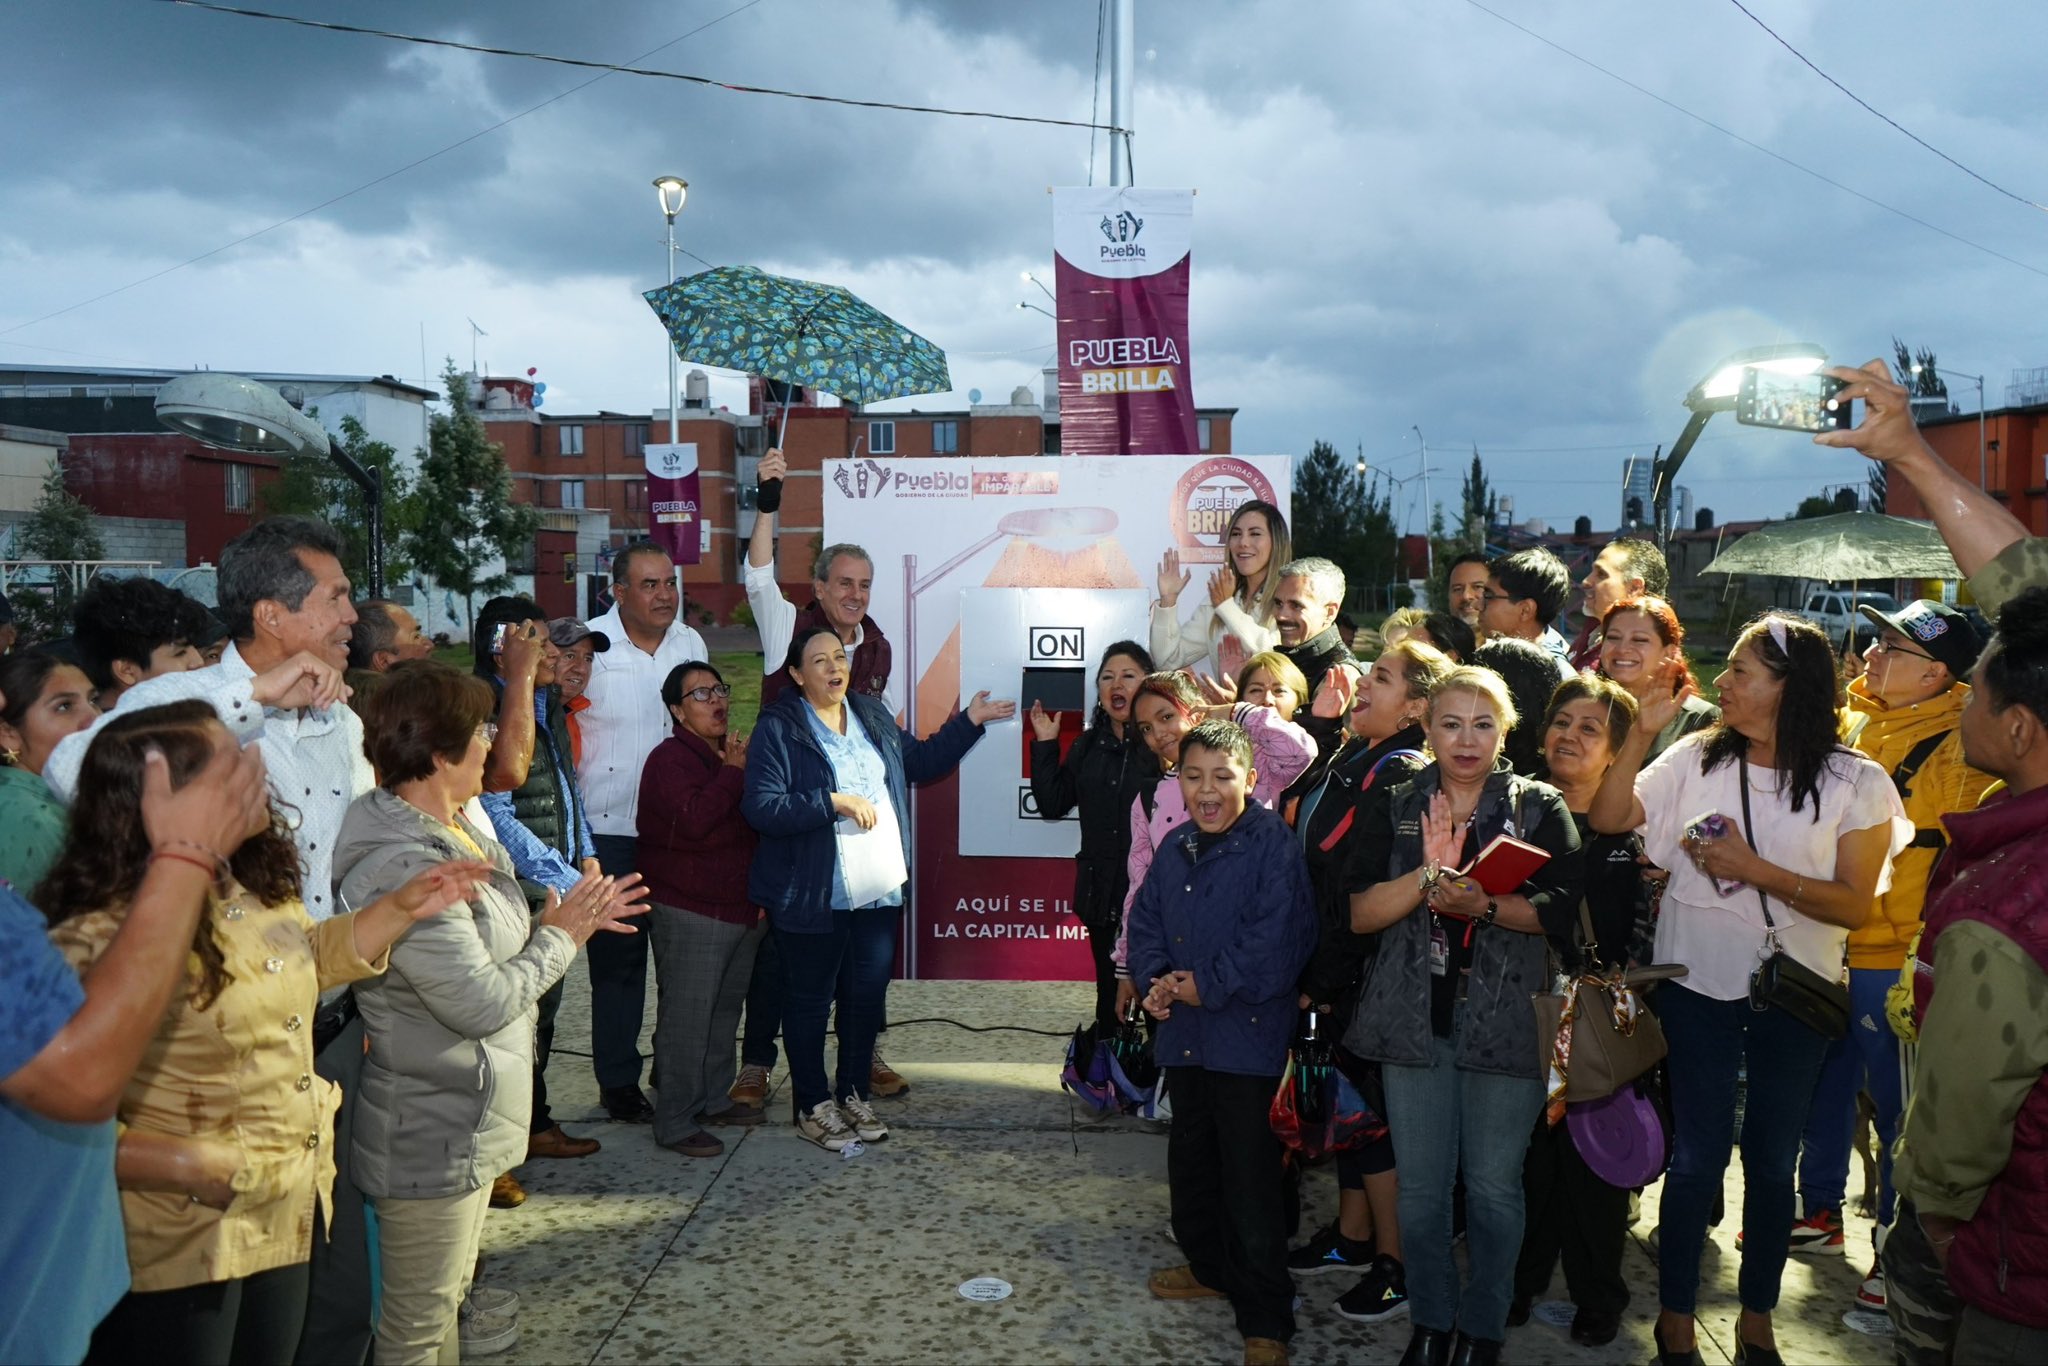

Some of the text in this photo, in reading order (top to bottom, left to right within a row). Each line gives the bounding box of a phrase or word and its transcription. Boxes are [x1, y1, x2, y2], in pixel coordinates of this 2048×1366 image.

[1100, 244, 1146, 258] Puebla
[1070, 337, 1181, 366] PUEBLA
[1082, 369, 1175, 393] BRILLA
[895, 472, 969, 490] Puebla
[1190, 469, 1207, 482] QUE
[1208, 465, 1219, 473] LA
[1221, 464, 1253, 479] CIUDAD
[1252, 477, 1263, 488] SE
[652, 501, 697, 512] PUEBLA
[1036, 634, 1079, 657] ON
[955, 894, 1073, 914] AQUÍ SE IL
[934, 923, 1090, 941] LA CAPITAL IMP
